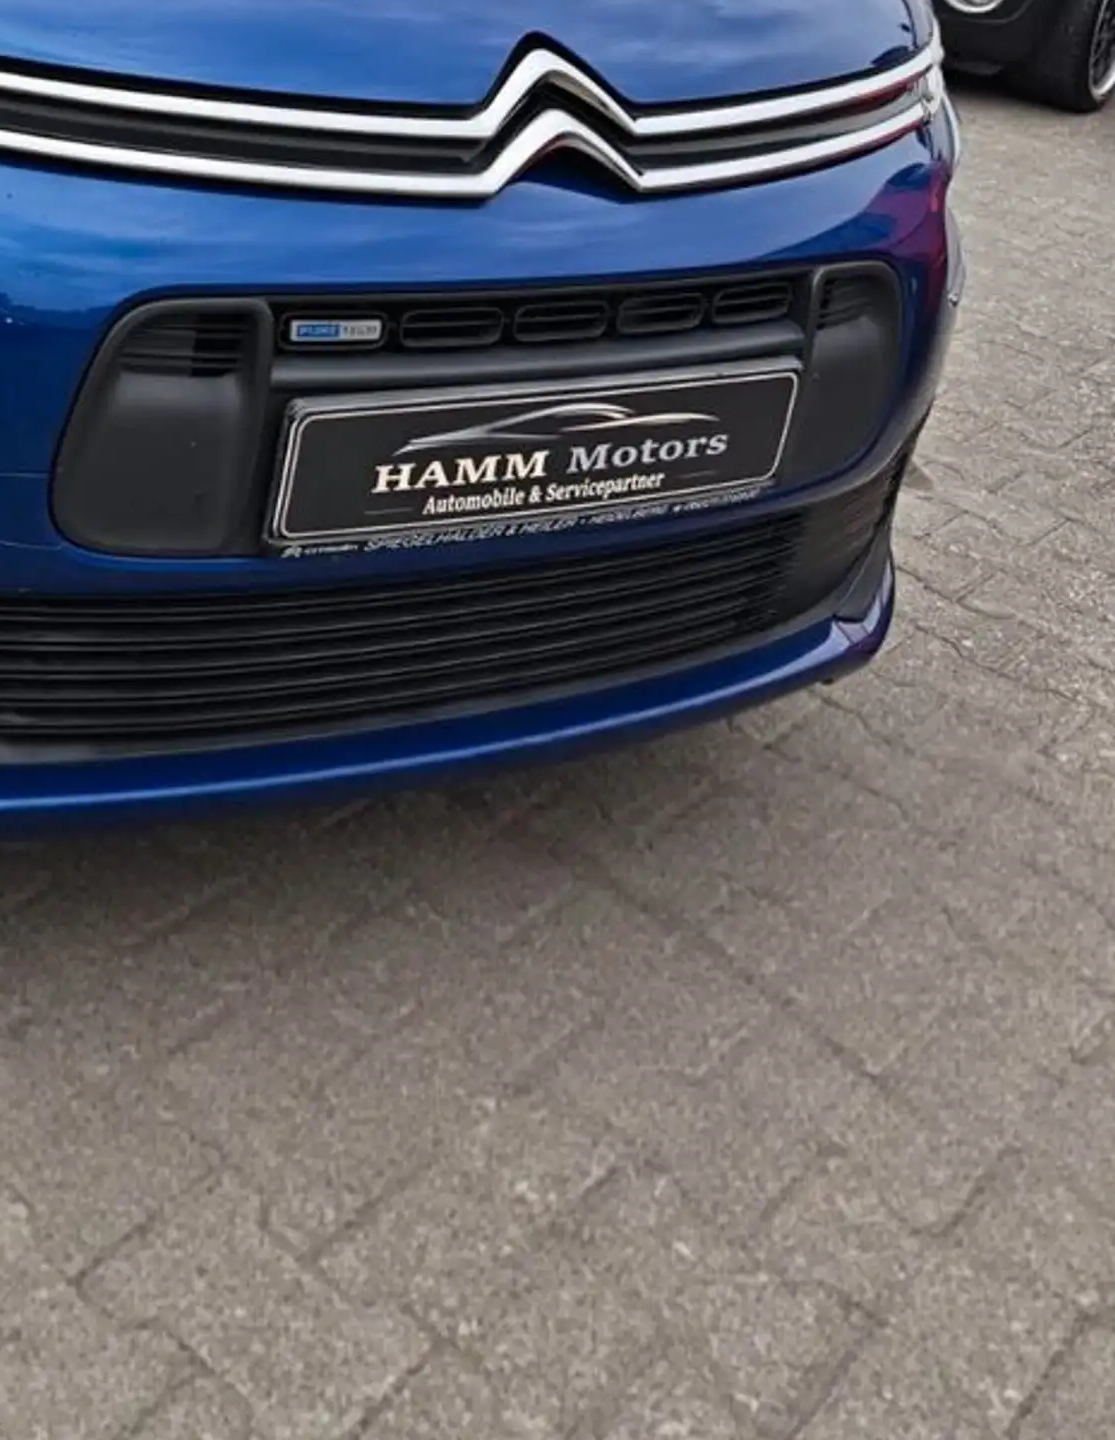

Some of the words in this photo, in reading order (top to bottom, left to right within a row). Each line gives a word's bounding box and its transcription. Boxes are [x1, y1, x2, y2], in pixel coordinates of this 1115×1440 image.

[371, 450, 550, 494] HAMM
[566, 434, 728, 474] Motors
[422, 486, 526, 515] Automobile
[528, 484, 543, 503] &
[545, 472, 665, 503] Servicepartner
